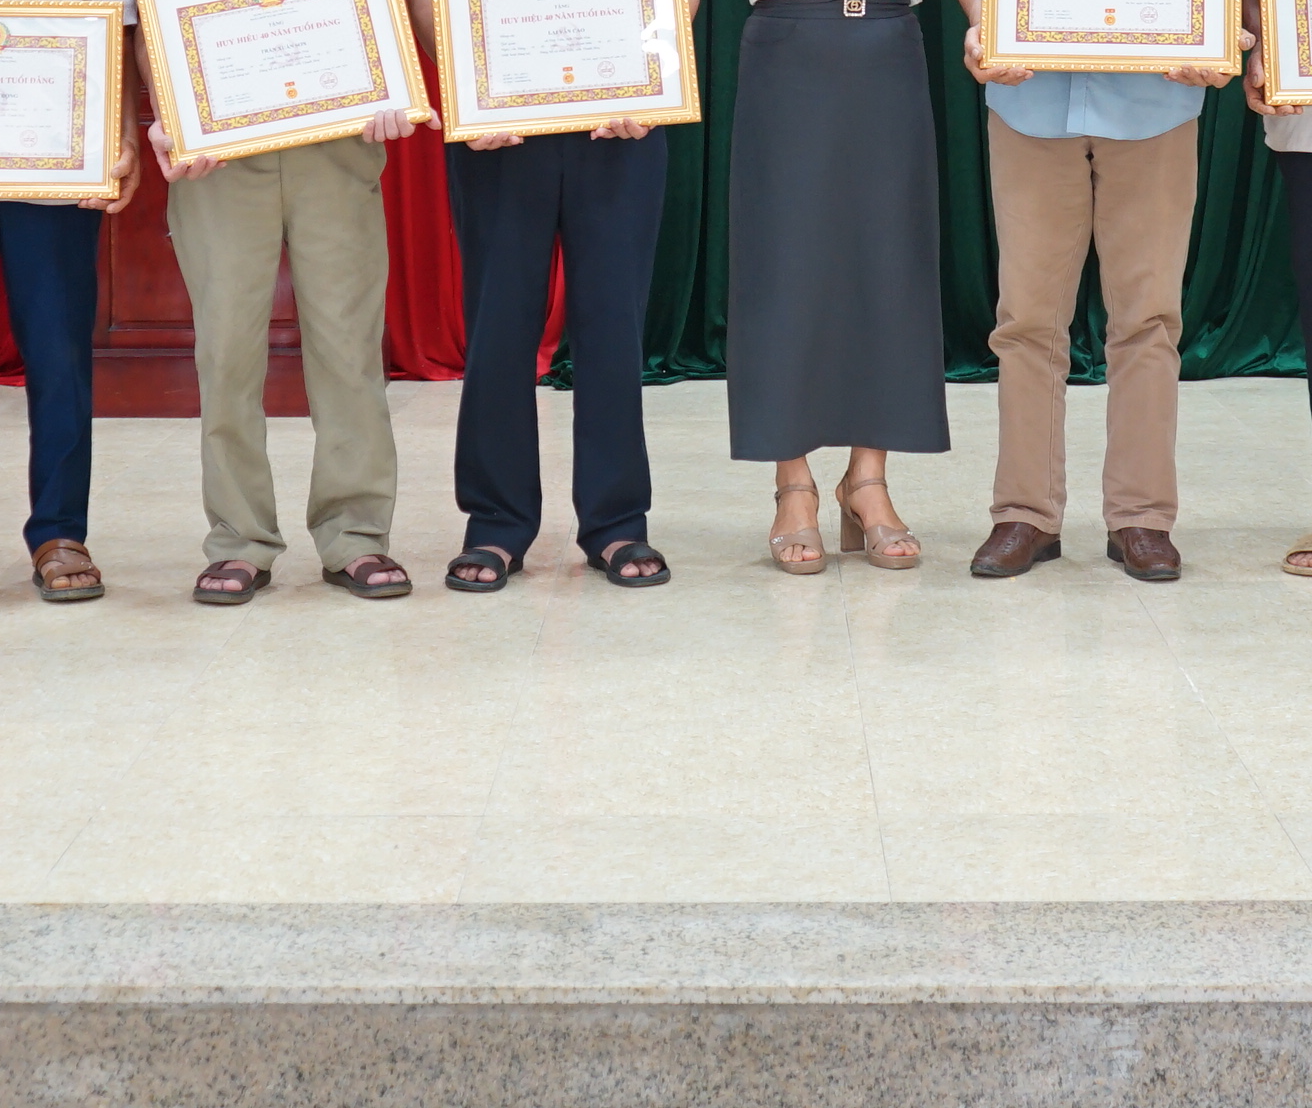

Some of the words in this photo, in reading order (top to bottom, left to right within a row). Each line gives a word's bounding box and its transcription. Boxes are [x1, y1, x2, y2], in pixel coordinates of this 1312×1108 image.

[521, 14, 542, 23] HIỆU
[555, 12, 575, 20] NĂM
[577, 9, 599, 18] TUỔI
[600, 8, 624, 17] ĐẢNG
[216, 39, 234, 48] HUY
[237, 33, 259, 43] HIỆU
[271, 28, 291, 38] NĂM
[293, 23, 314, 33] TUỔI
[316, 19, 340, 29] ĐẢNG
[6, 74, 27, 84] TUỔI
[29, 76, 54, 84] ĐẢNG
